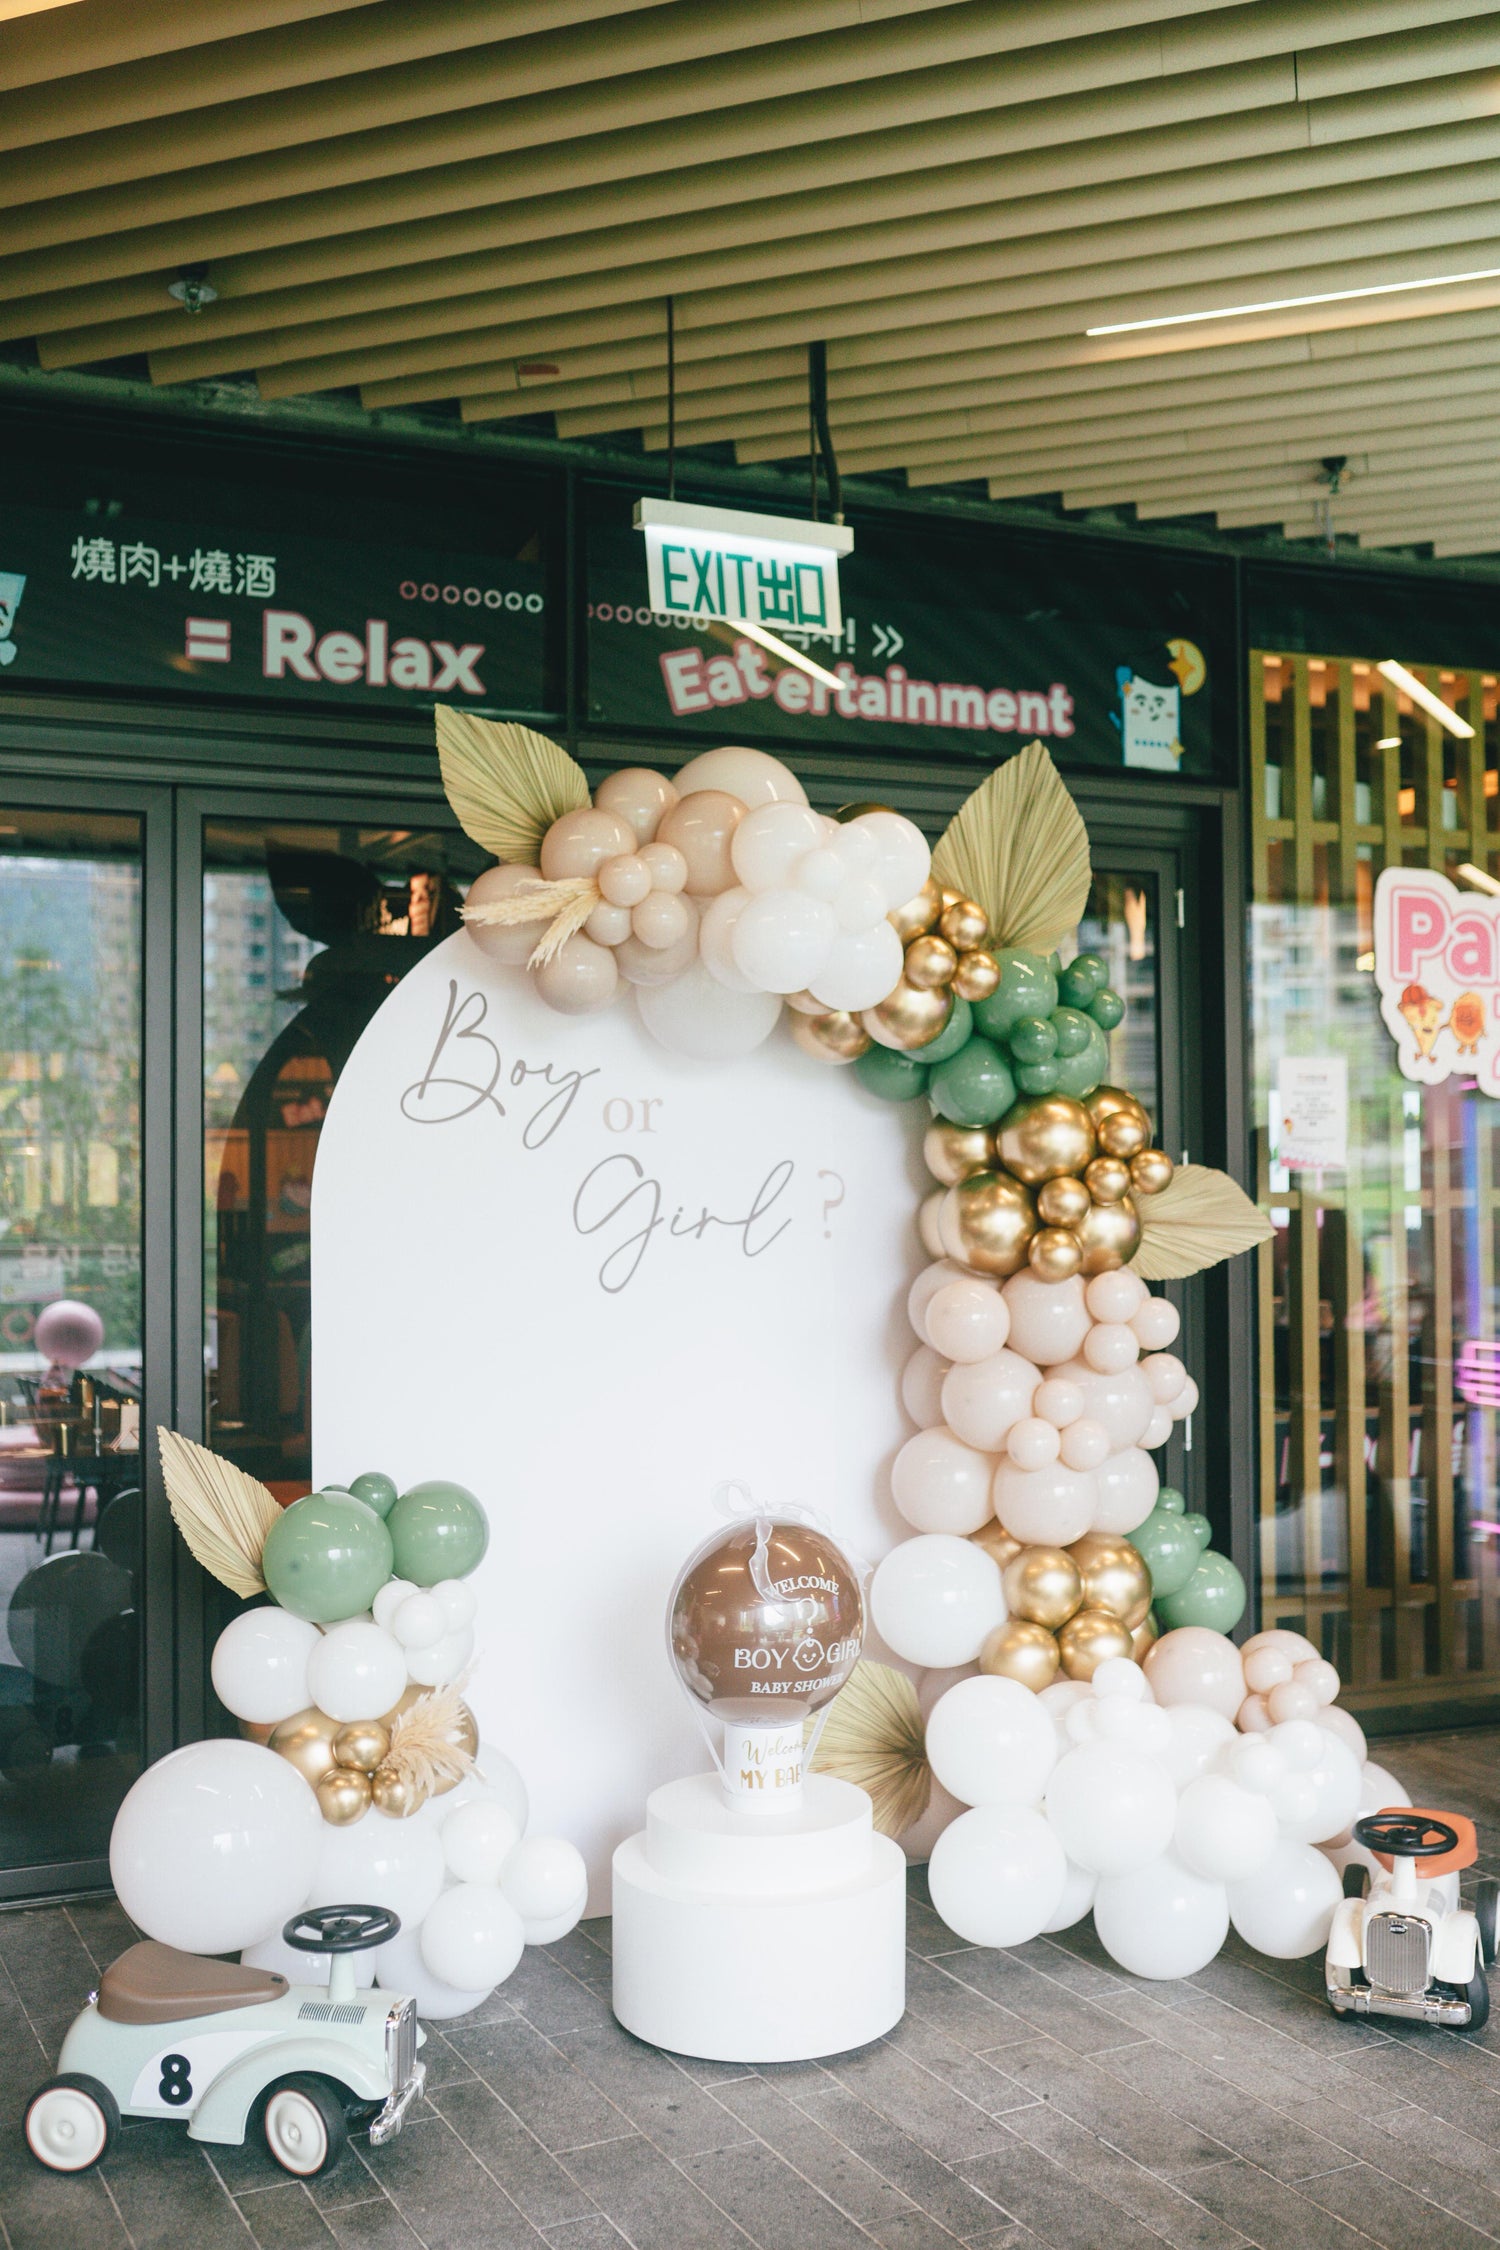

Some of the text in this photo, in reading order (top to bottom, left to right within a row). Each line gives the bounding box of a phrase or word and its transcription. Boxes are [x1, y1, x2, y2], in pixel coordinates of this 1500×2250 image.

[71, 535, 277, 599] 燒肉+燒酒
[662, 543, 828, 629] EXIT 出口
[262, 609, 486, 695] Relax
[400, 979, 600, 1149] Boy
[602, 1096, 663, 1133] or
[573, 1153, 845, 1294] Girl ?
[764, 1575, 840, 1596] WELCOME
[734, 1647, 790, 1670] BOY
[750, 1681, 792, 1694] BABY
[740, 1768, 768, 1789] MY
[159, 2053, 193, 2106] 8
